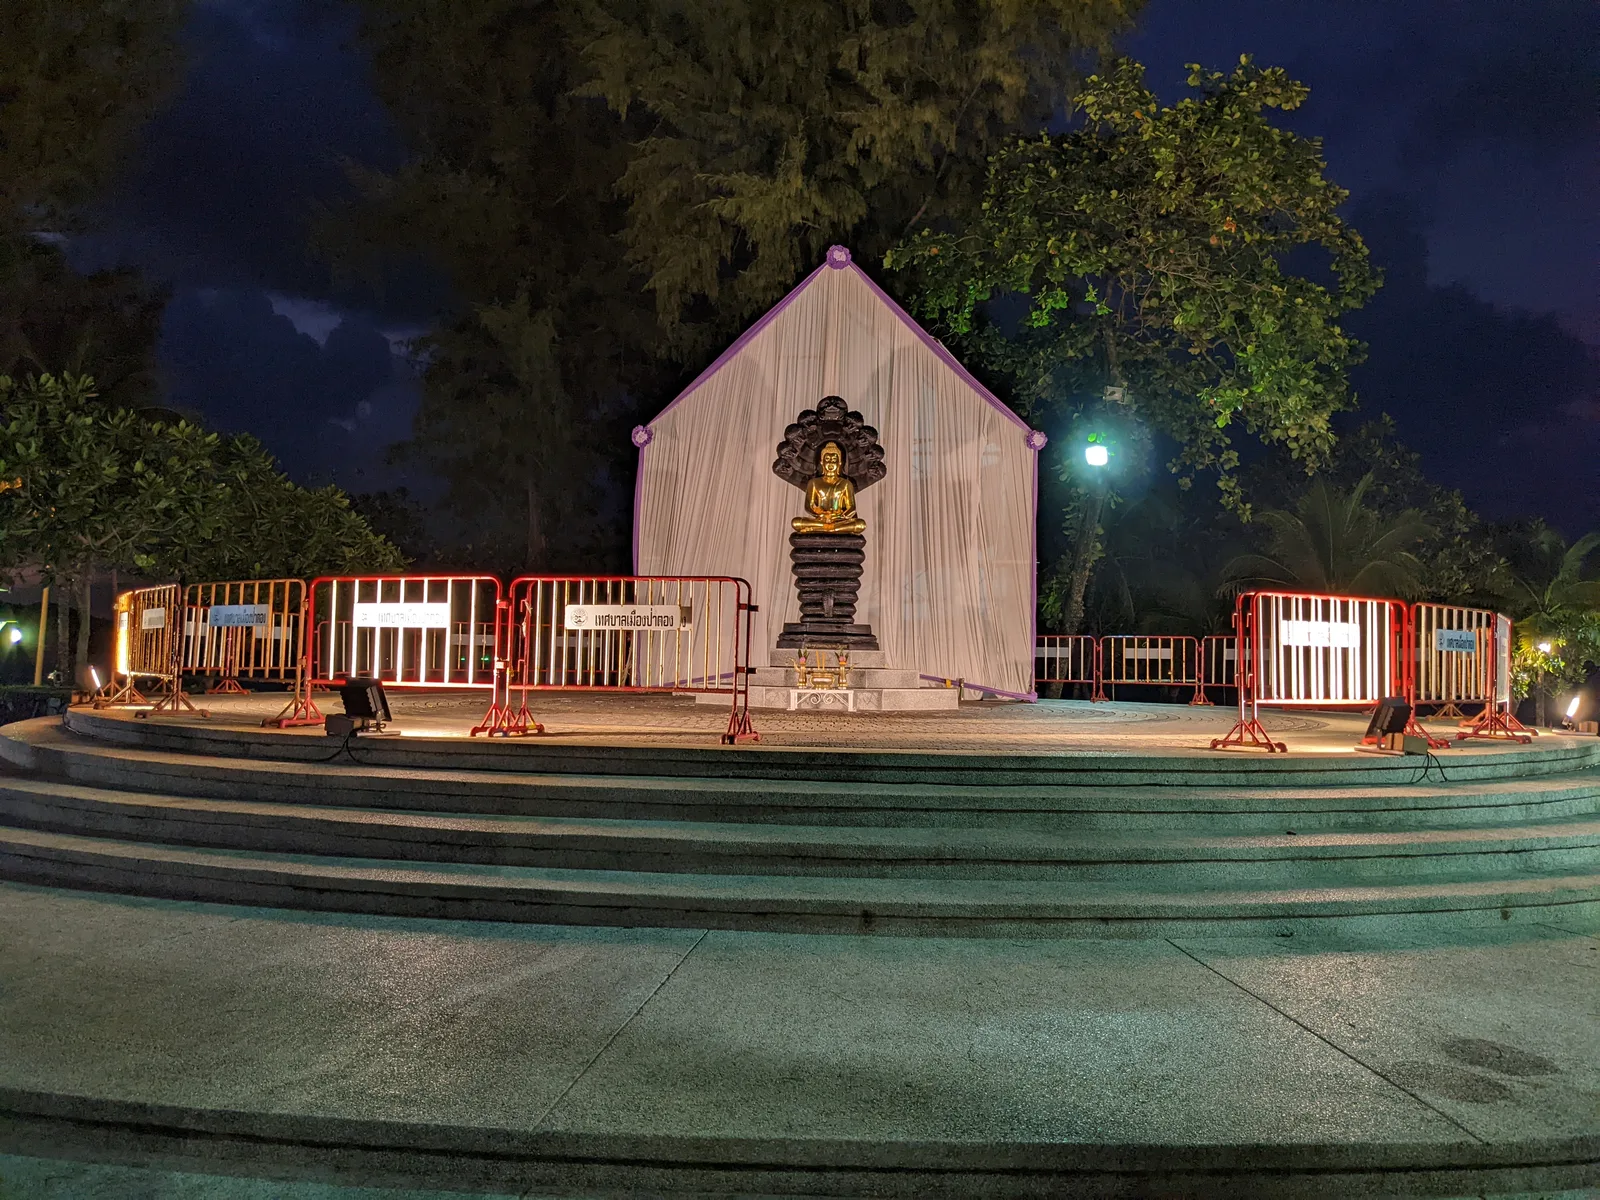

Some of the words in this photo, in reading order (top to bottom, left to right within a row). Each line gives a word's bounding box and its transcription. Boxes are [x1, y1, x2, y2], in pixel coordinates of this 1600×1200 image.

[595, 608, 674, 627] เทศบาลเมืองป่าตอง
